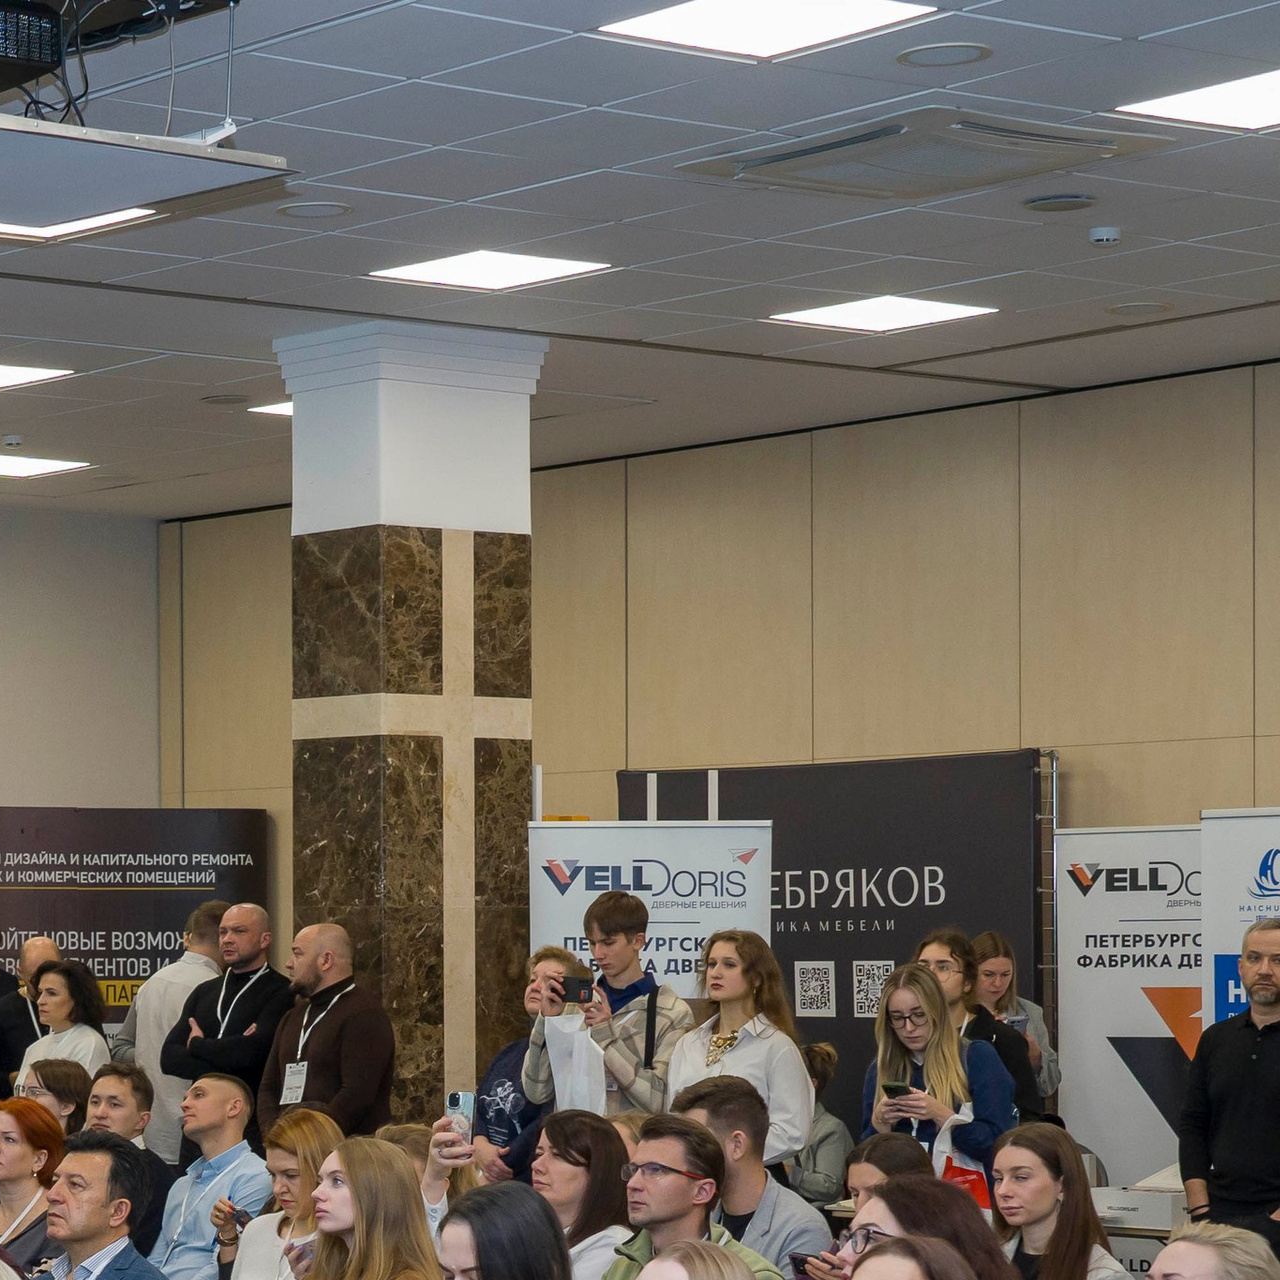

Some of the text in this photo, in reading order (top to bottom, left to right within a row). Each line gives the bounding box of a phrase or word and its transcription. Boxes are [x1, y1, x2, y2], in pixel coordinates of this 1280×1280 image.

[4, 851, 65, 867] ДИЗАЙНА
[70, 853, 80, 866] И
[83, 853, 188, 866] КАПИТАЛЬНОГО
[192, 854, 254, 867] РЕМОНТА
[5, 870, 15, 883] И
[17, 870, 122, 884] КОММЕРЧЕСКИХ
[126, 869, 216, 886] ПОМЕЩЕНИЙ
[541, 859, 747, 897] VELLDORIS
[651, 901, 747, 910] ДВЕРНЫЕ РЕШЕНИЯ
[819, 919, 895, 932] МЕБЕЛИ
[1076, 953, 1173, 969] ФАБРИКА
